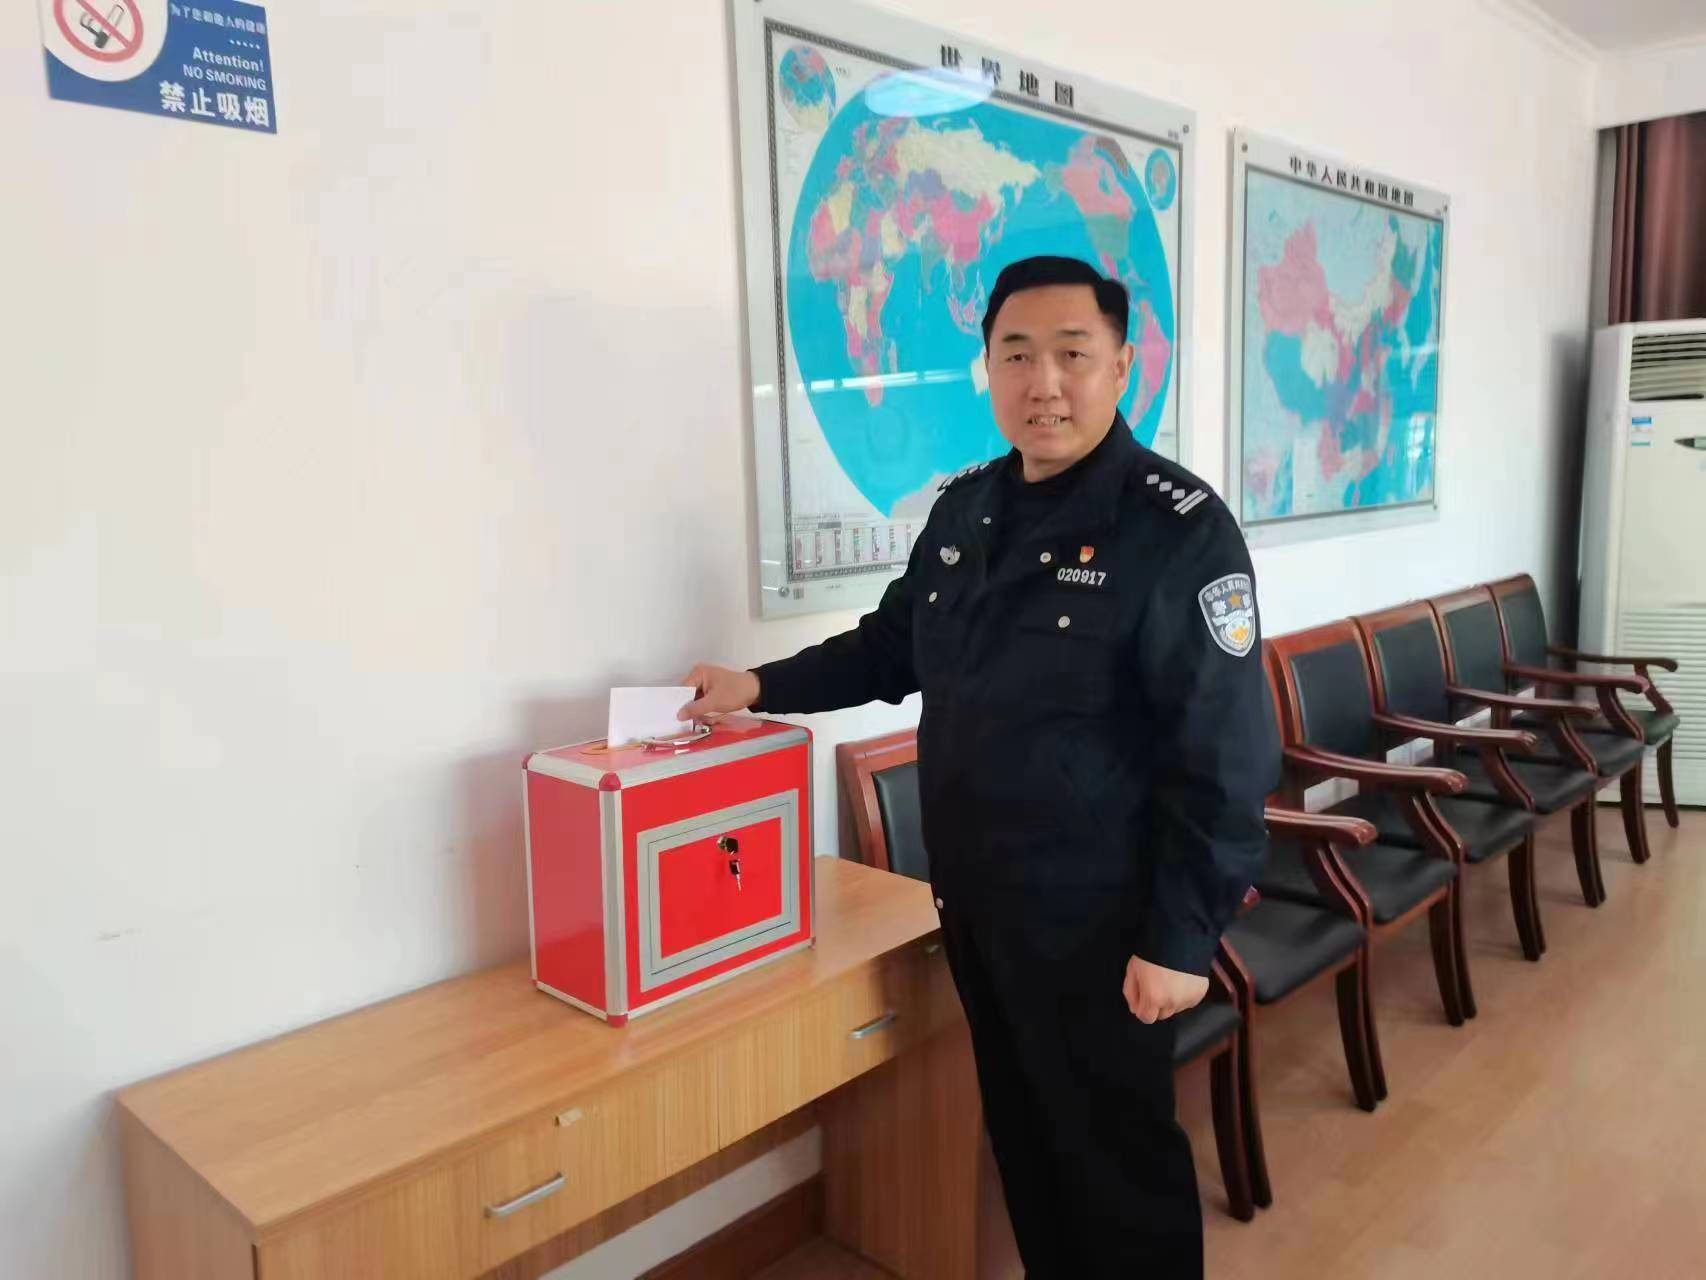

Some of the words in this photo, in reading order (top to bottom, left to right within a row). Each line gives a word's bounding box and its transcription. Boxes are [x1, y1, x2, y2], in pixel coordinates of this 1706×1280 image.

[193, 46, 265, 73] Attention!
[183, 64, 203, 80] NO
[205, 69, 266, 91] SMOKING
[159, 80, 269, 127] 禁止吸烟
[1289, 155, 1414, 206] 中华人民共和国地图
[1057, 567, 1107, 586] 020917
